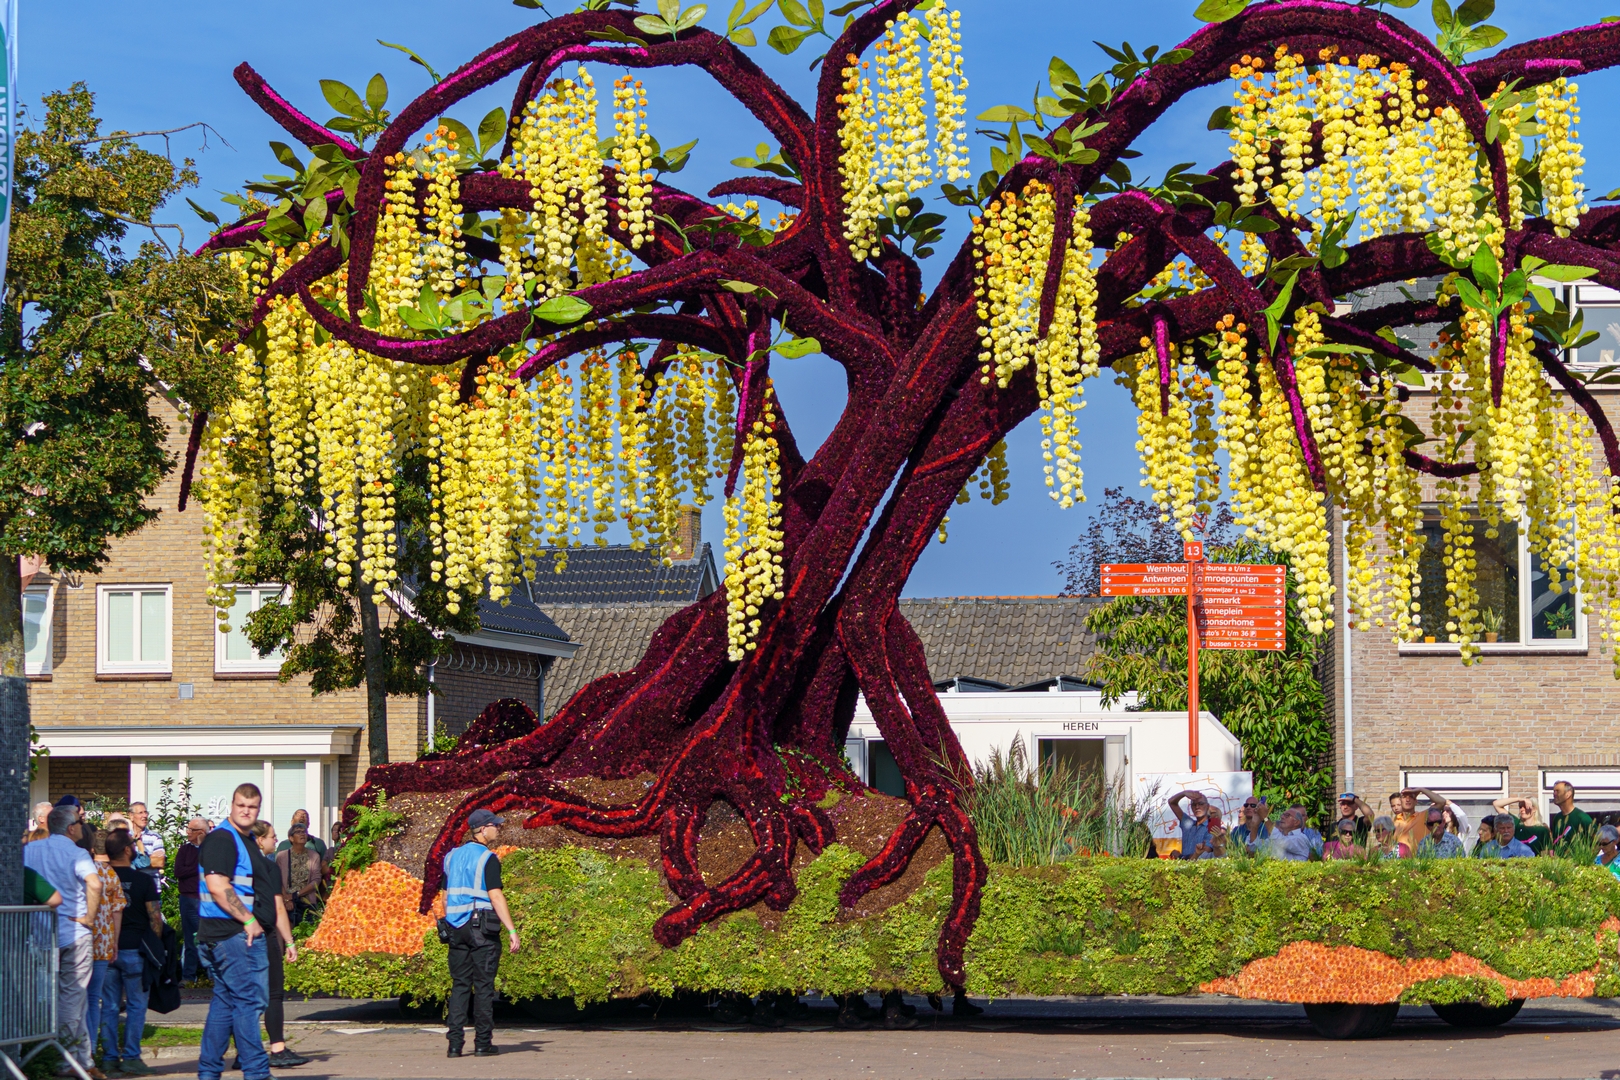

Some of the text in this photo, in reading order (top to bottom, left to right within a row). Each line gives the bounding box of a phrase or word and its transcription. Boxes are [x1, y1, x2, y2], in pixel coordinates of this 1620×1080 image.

[1187, 546, 1200, 556] 13
[1146, 565, 1186, 573] Wernhout
[1142, 575, 1186, 584] Antwerpen
[1200, 607, 1243, 616] zonneplein
[1200, 618, 1255, 627] sponsorhome
[1063, 722, 1099, 731] HEREN
